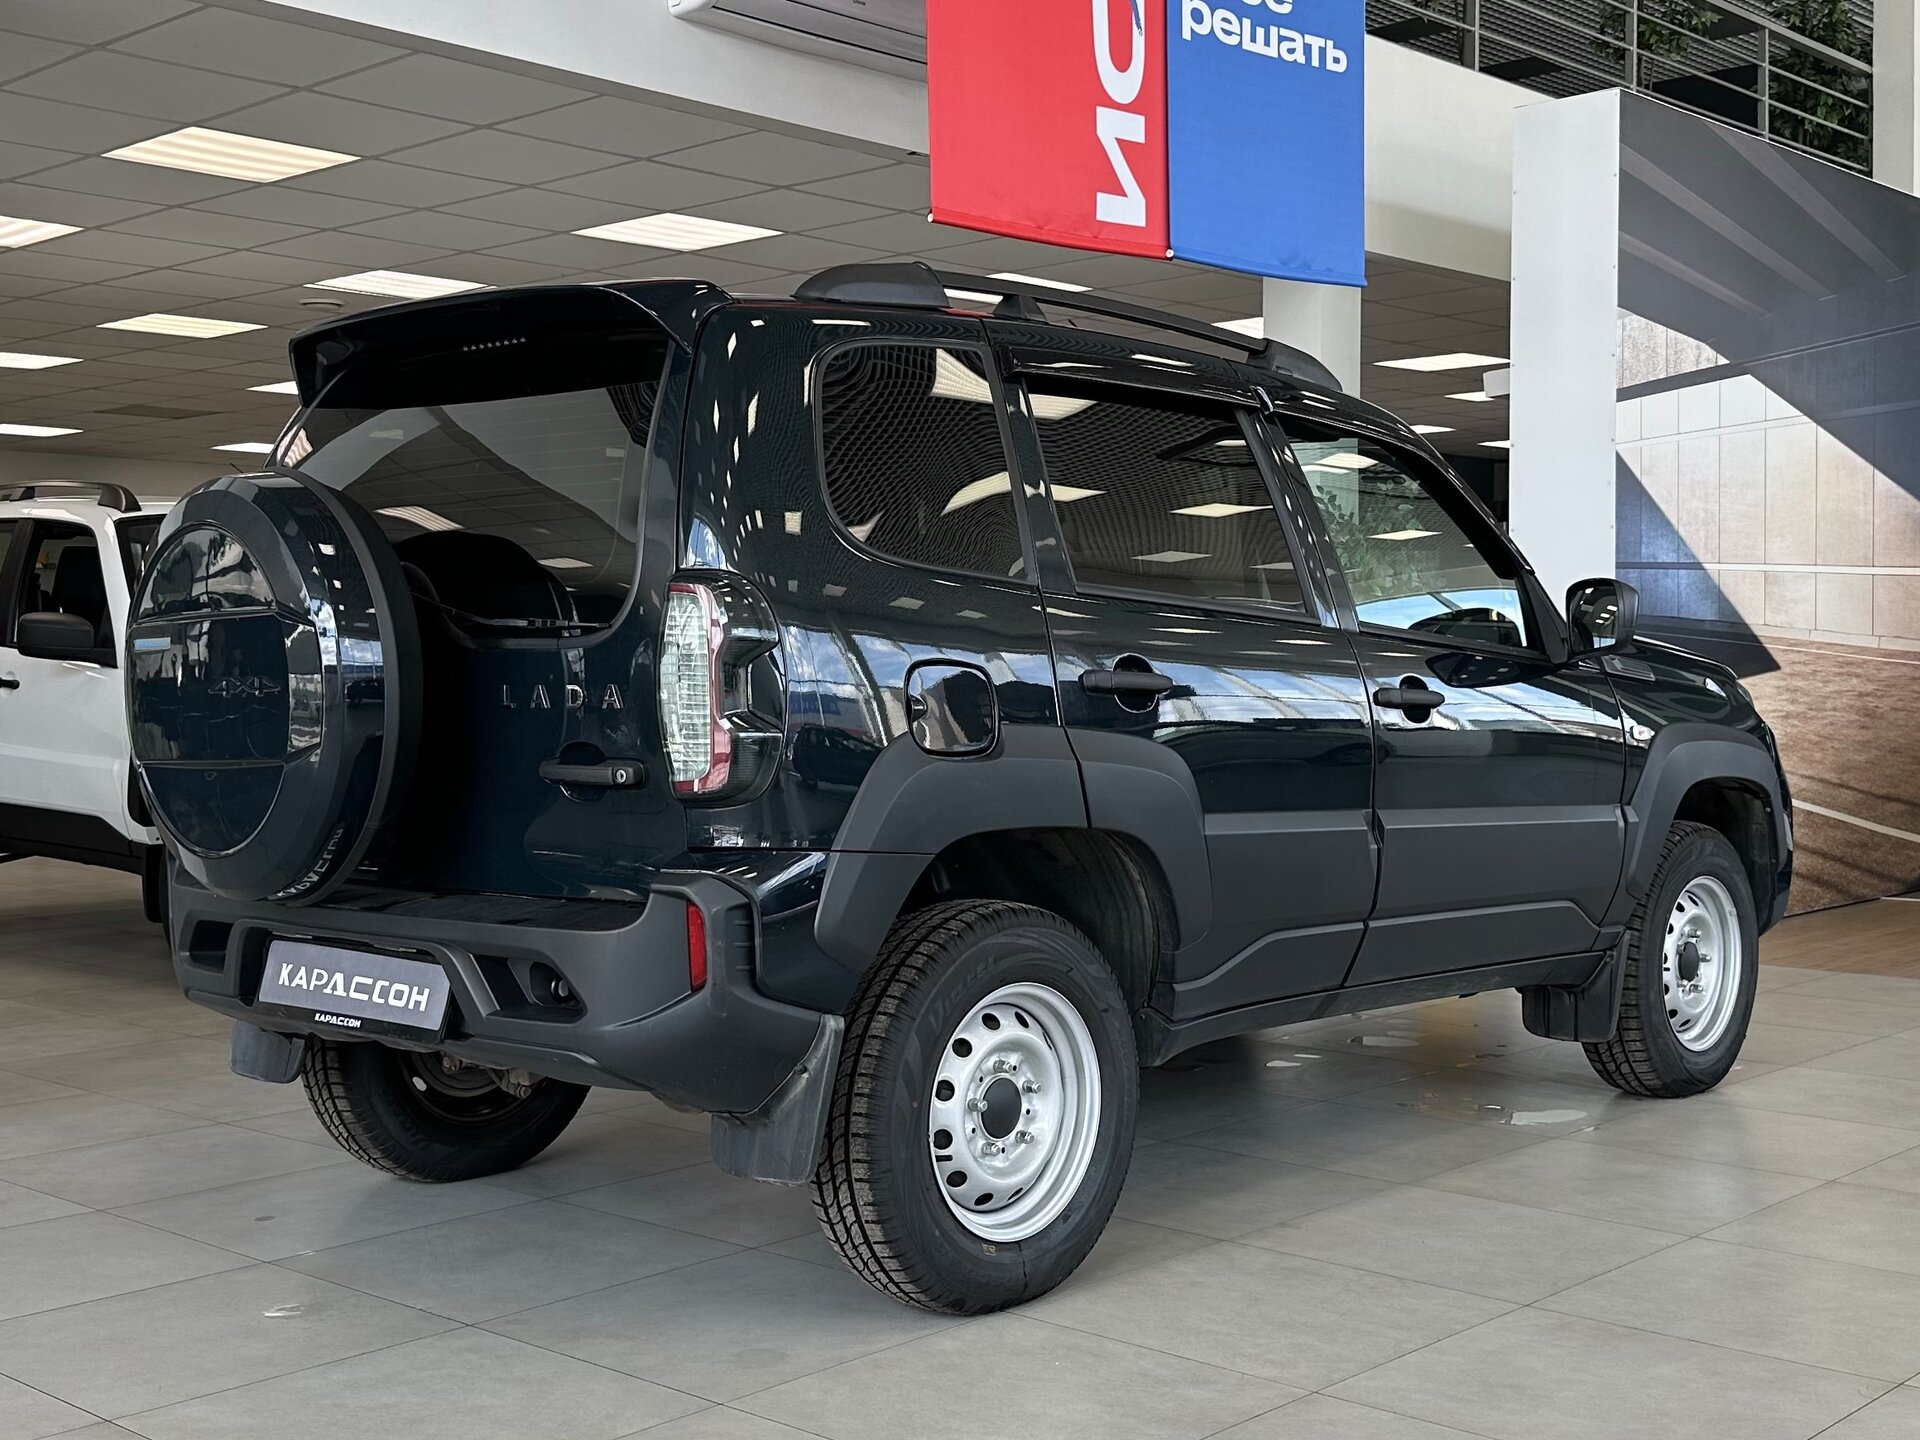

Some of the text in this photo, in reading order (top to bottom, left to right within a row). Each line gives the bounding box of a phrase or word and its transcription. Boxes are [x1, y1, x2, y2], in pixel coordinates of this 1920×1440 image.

[1181, 0, 1348, 73] решать
[501, 684, 624, 709] LADA
[278, 962, 431, 1012] КАРАССОН
